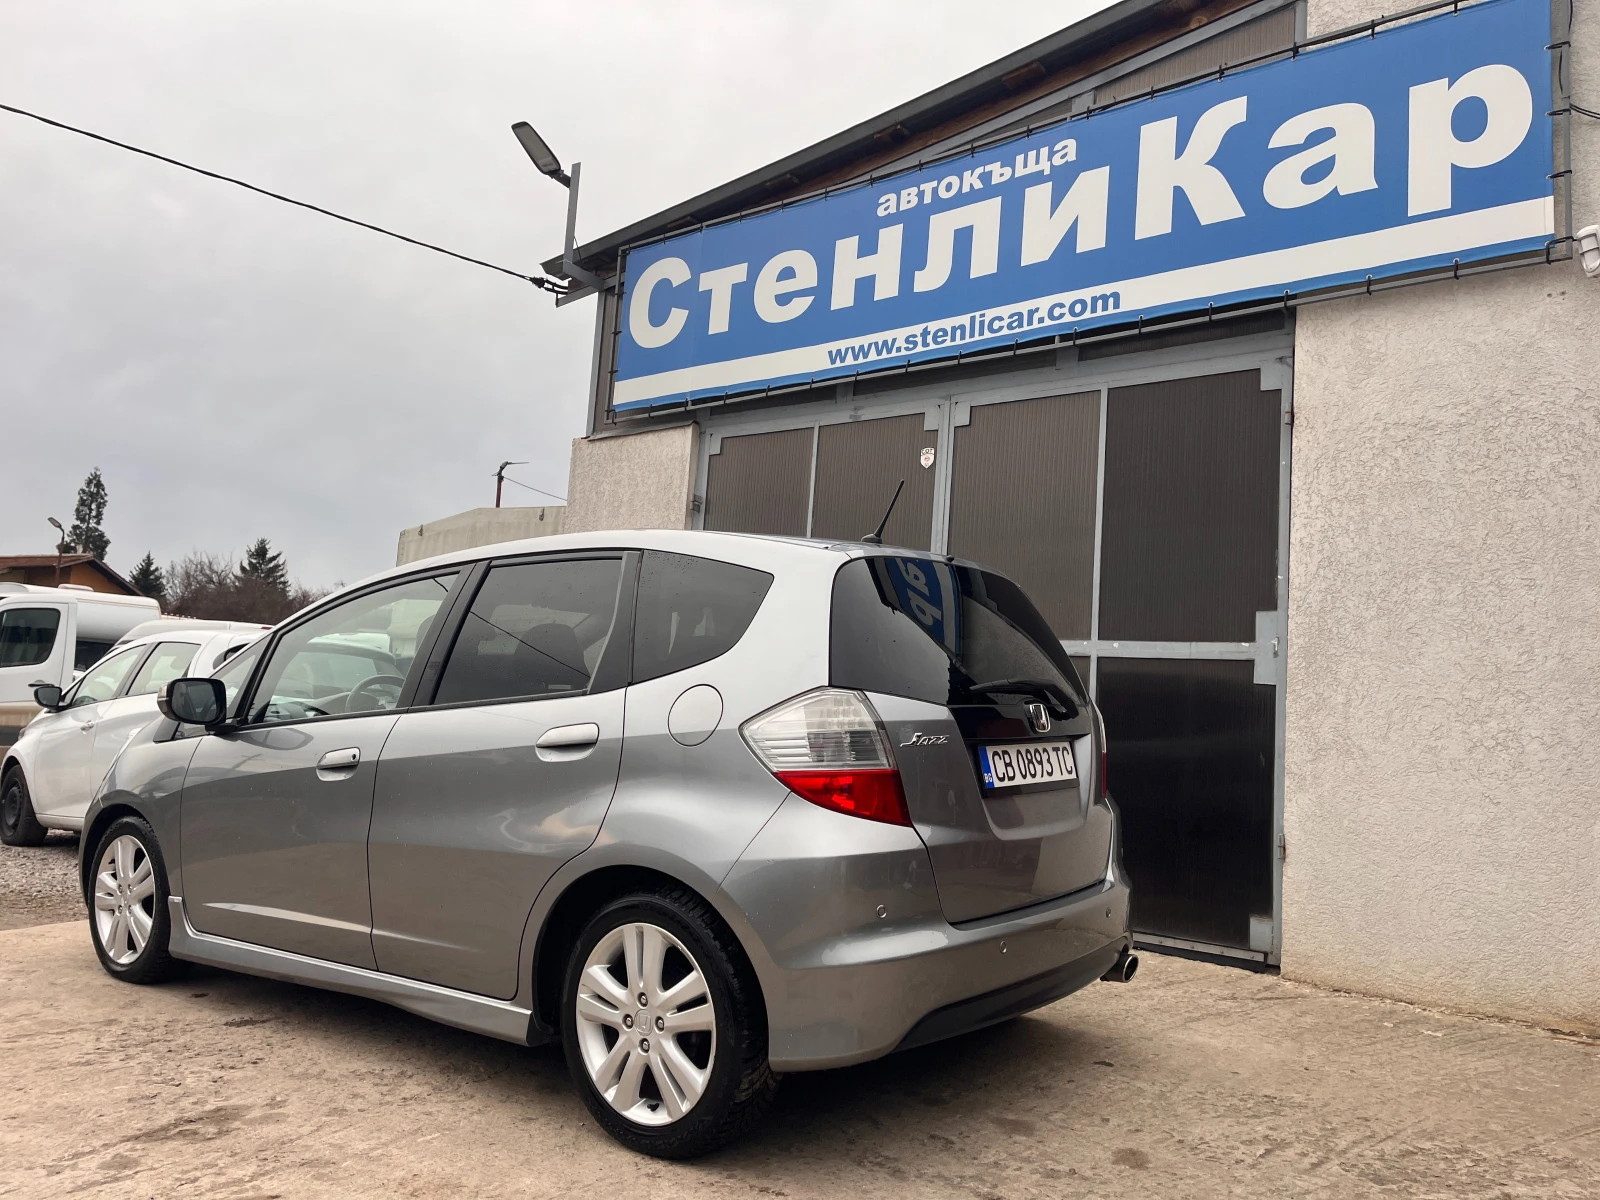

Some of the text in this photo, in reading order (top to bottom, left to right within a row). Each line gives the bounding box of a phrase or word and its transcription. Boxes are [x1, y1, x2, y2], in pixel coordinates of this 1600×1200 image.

[628, 64, 1534, 349] СтенлиКар
[876, 137, 1077, 218] автокъща
[828, 290, 1121, 366] www.stenlicar.com
[1016, 747, 1053, 780] 0893
